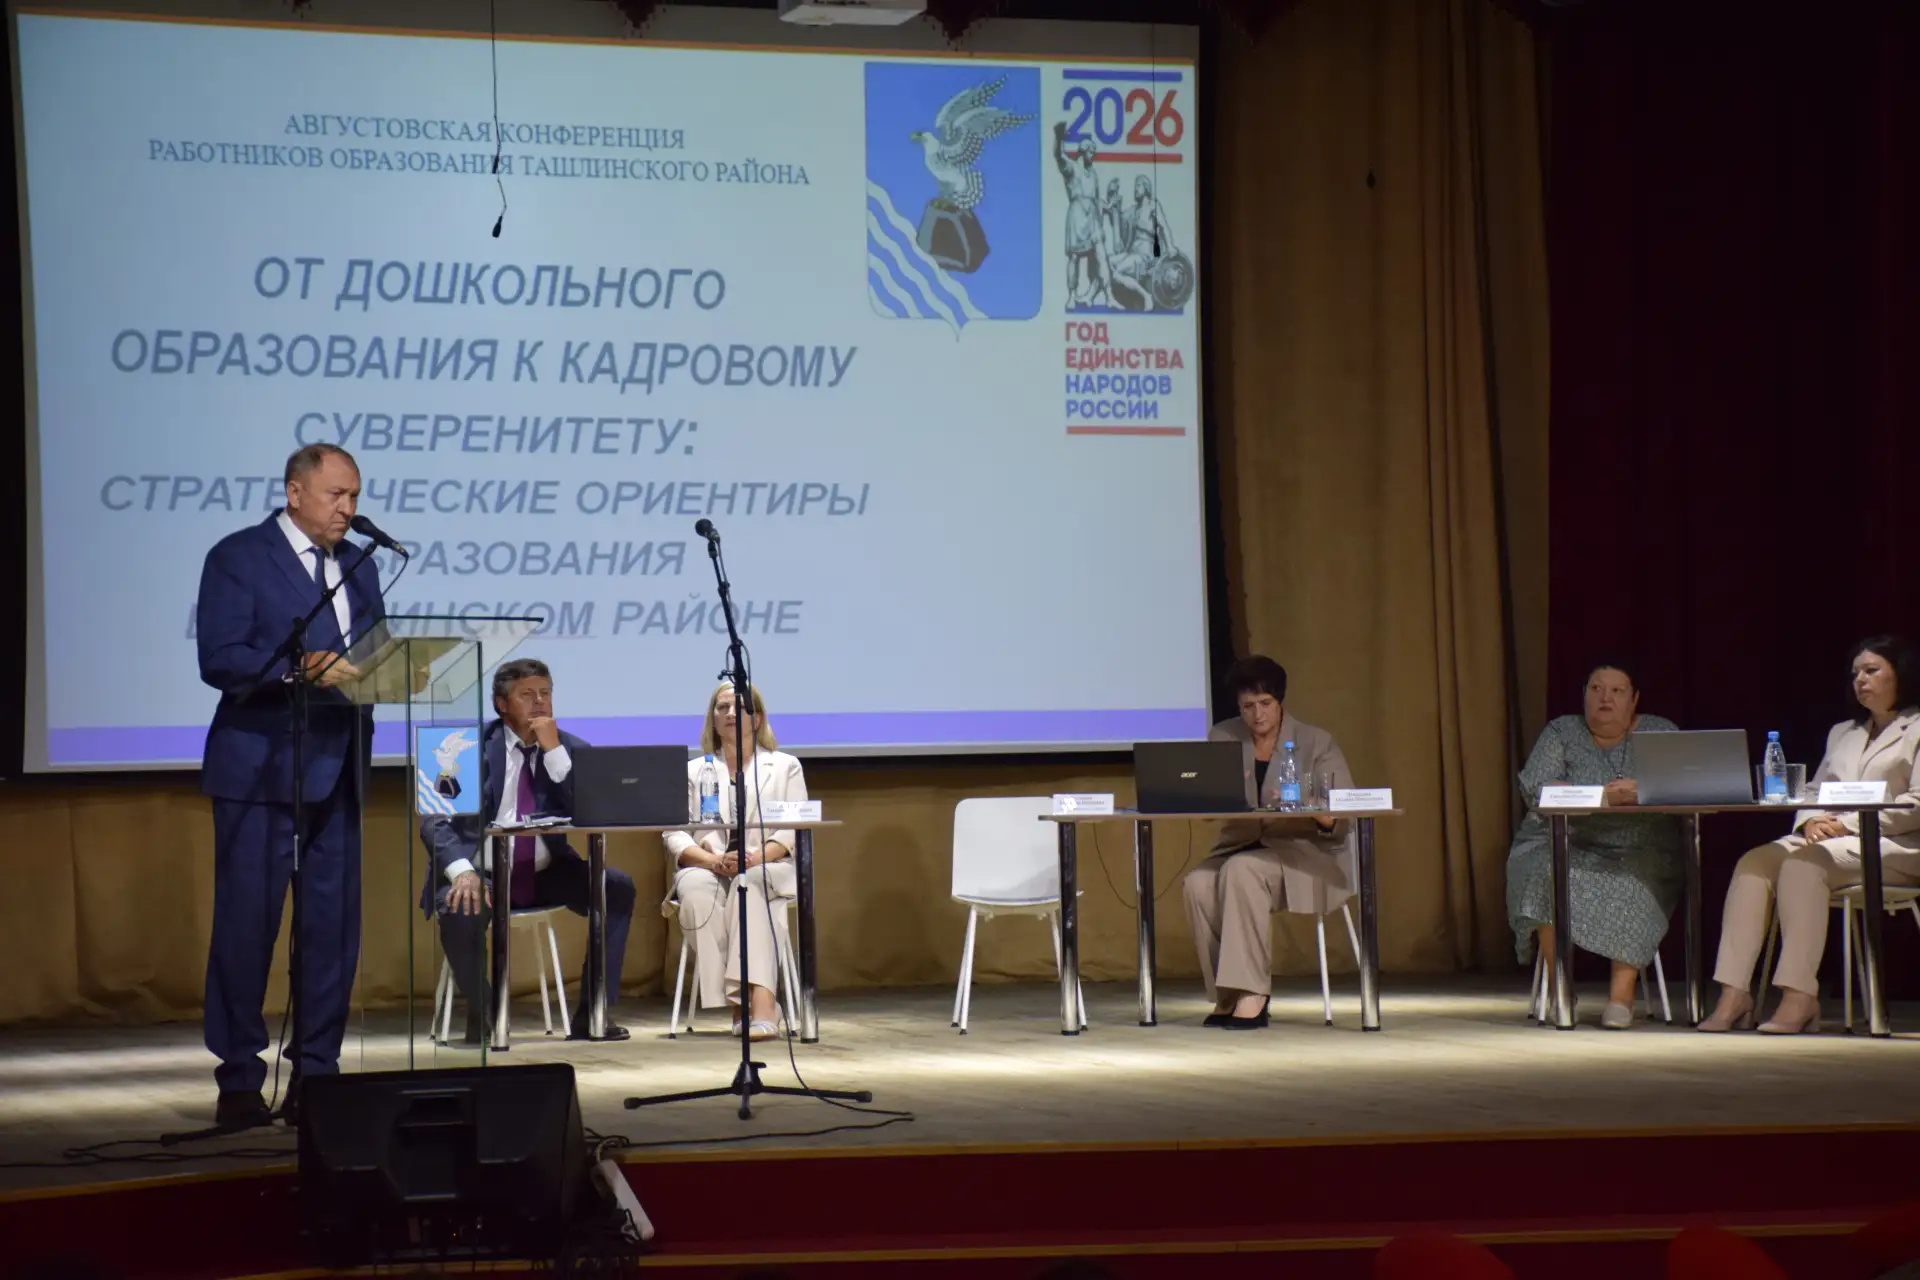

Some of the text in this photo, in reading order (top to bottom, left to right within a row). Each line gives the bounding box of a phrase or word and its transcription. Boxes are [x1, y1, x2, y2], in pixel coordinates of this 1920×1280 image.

[285, 114, 686, 150] АВГУСТОВСКАЯ КОНФЕРЕНЦИЯ
[1062, 87, 1184, 147] 2026
[148, 138, 811, 186] РАБОТНИКОВ ОБРАЗОВАНИЯ ТАШЛИНСКОГО РАЙОНА
[254, 256, 726, 312] ОТ ДОШКОЛЬНОГО
[1065, 321, 1109, 345] ГОД
[111, 328, 858, 396] ОБРАЗОВАНИЯ К КАДРОВОМУ
[1065, 347, 1184, 371] ЕДИНСТВА
[1065, 373, 1173, 398] НАРОДОВ
[1065, 399, 1159, 420] РОССИИ
[293, 411, 698, 456] СУВЕРЕНИТЕТУ:
[100, 475, 870, 518] СТРАТЕЧЕСКИЕ ОРИЕНТИРЫ
[362, 539, 687, 577] РАЗОВАНИЯ
[612, 591, 804, 636] РАЙОНЕ
